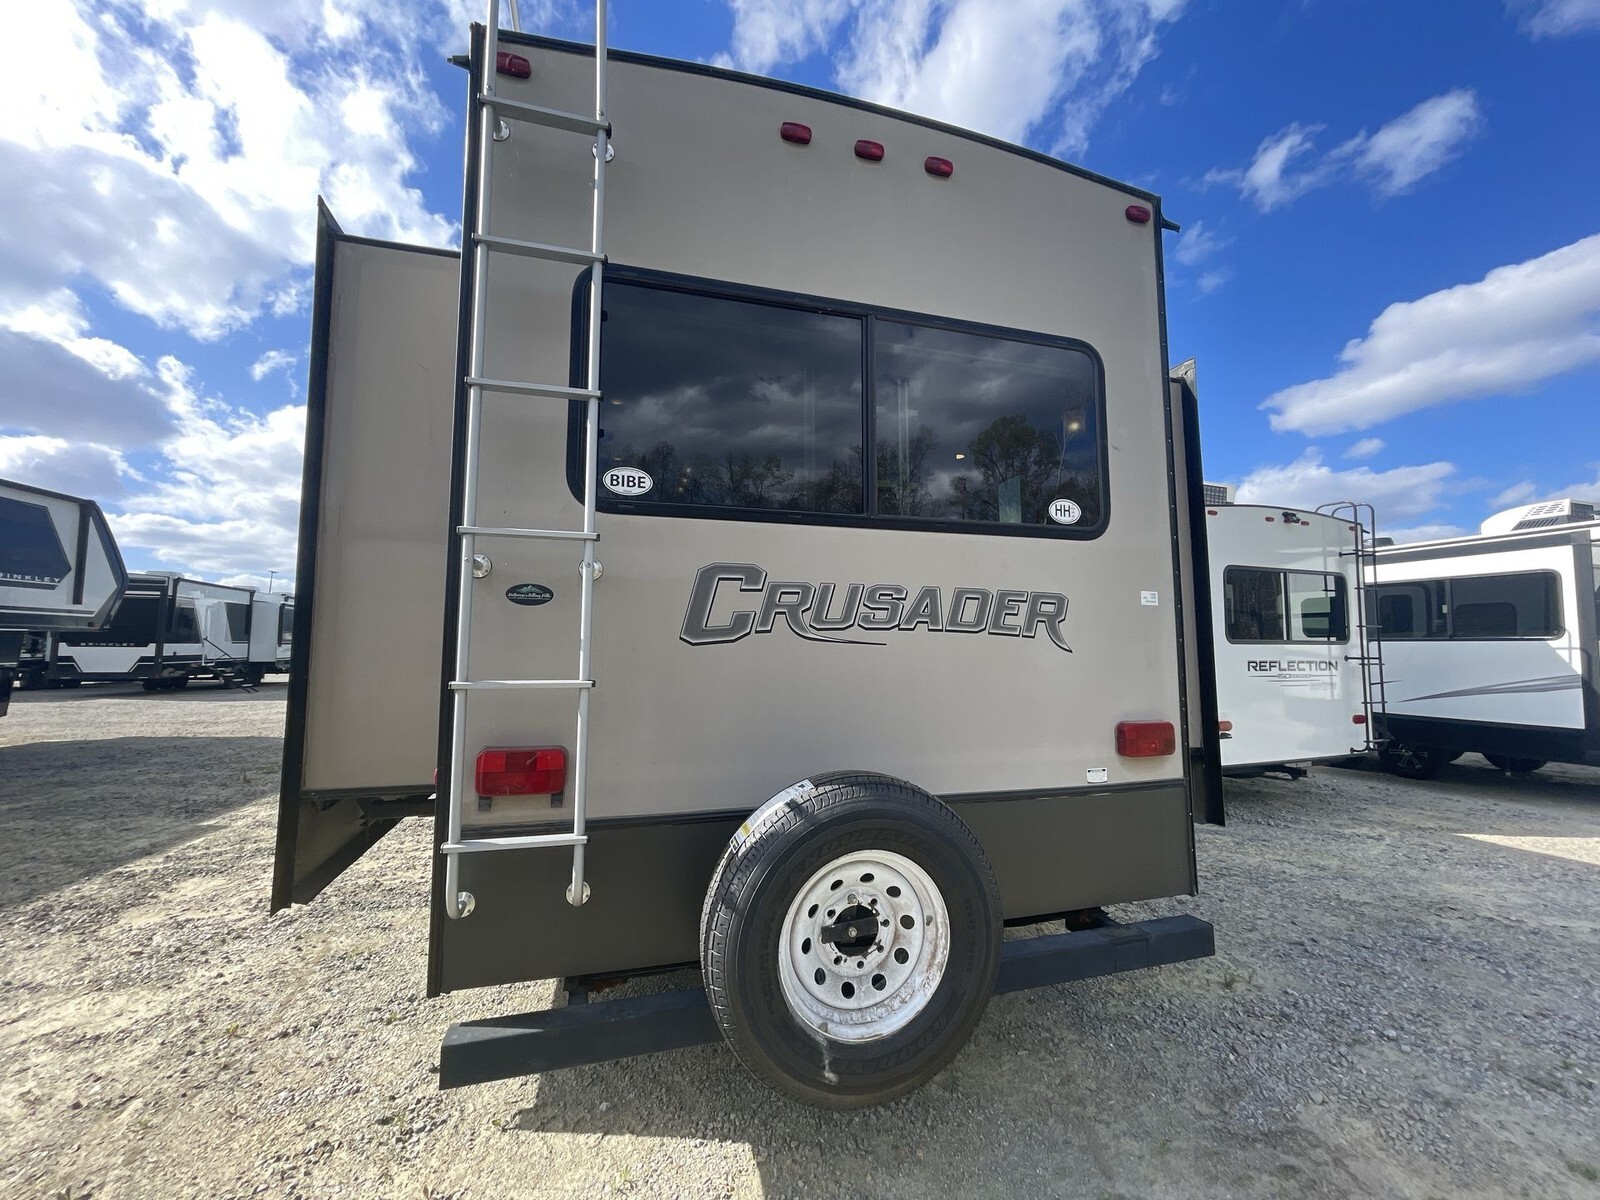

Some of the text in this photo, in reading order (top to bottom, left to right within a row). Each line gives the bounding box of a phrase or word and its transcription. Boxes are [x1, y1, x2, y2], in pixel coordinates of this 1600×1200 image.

[610, 474, 646, 489] BIBE
[1055, 504, 1071, 517] HH
[679, 562, 1072, 653] CRUSADER
[1247, 660, 1338, 672] REFLECTION
